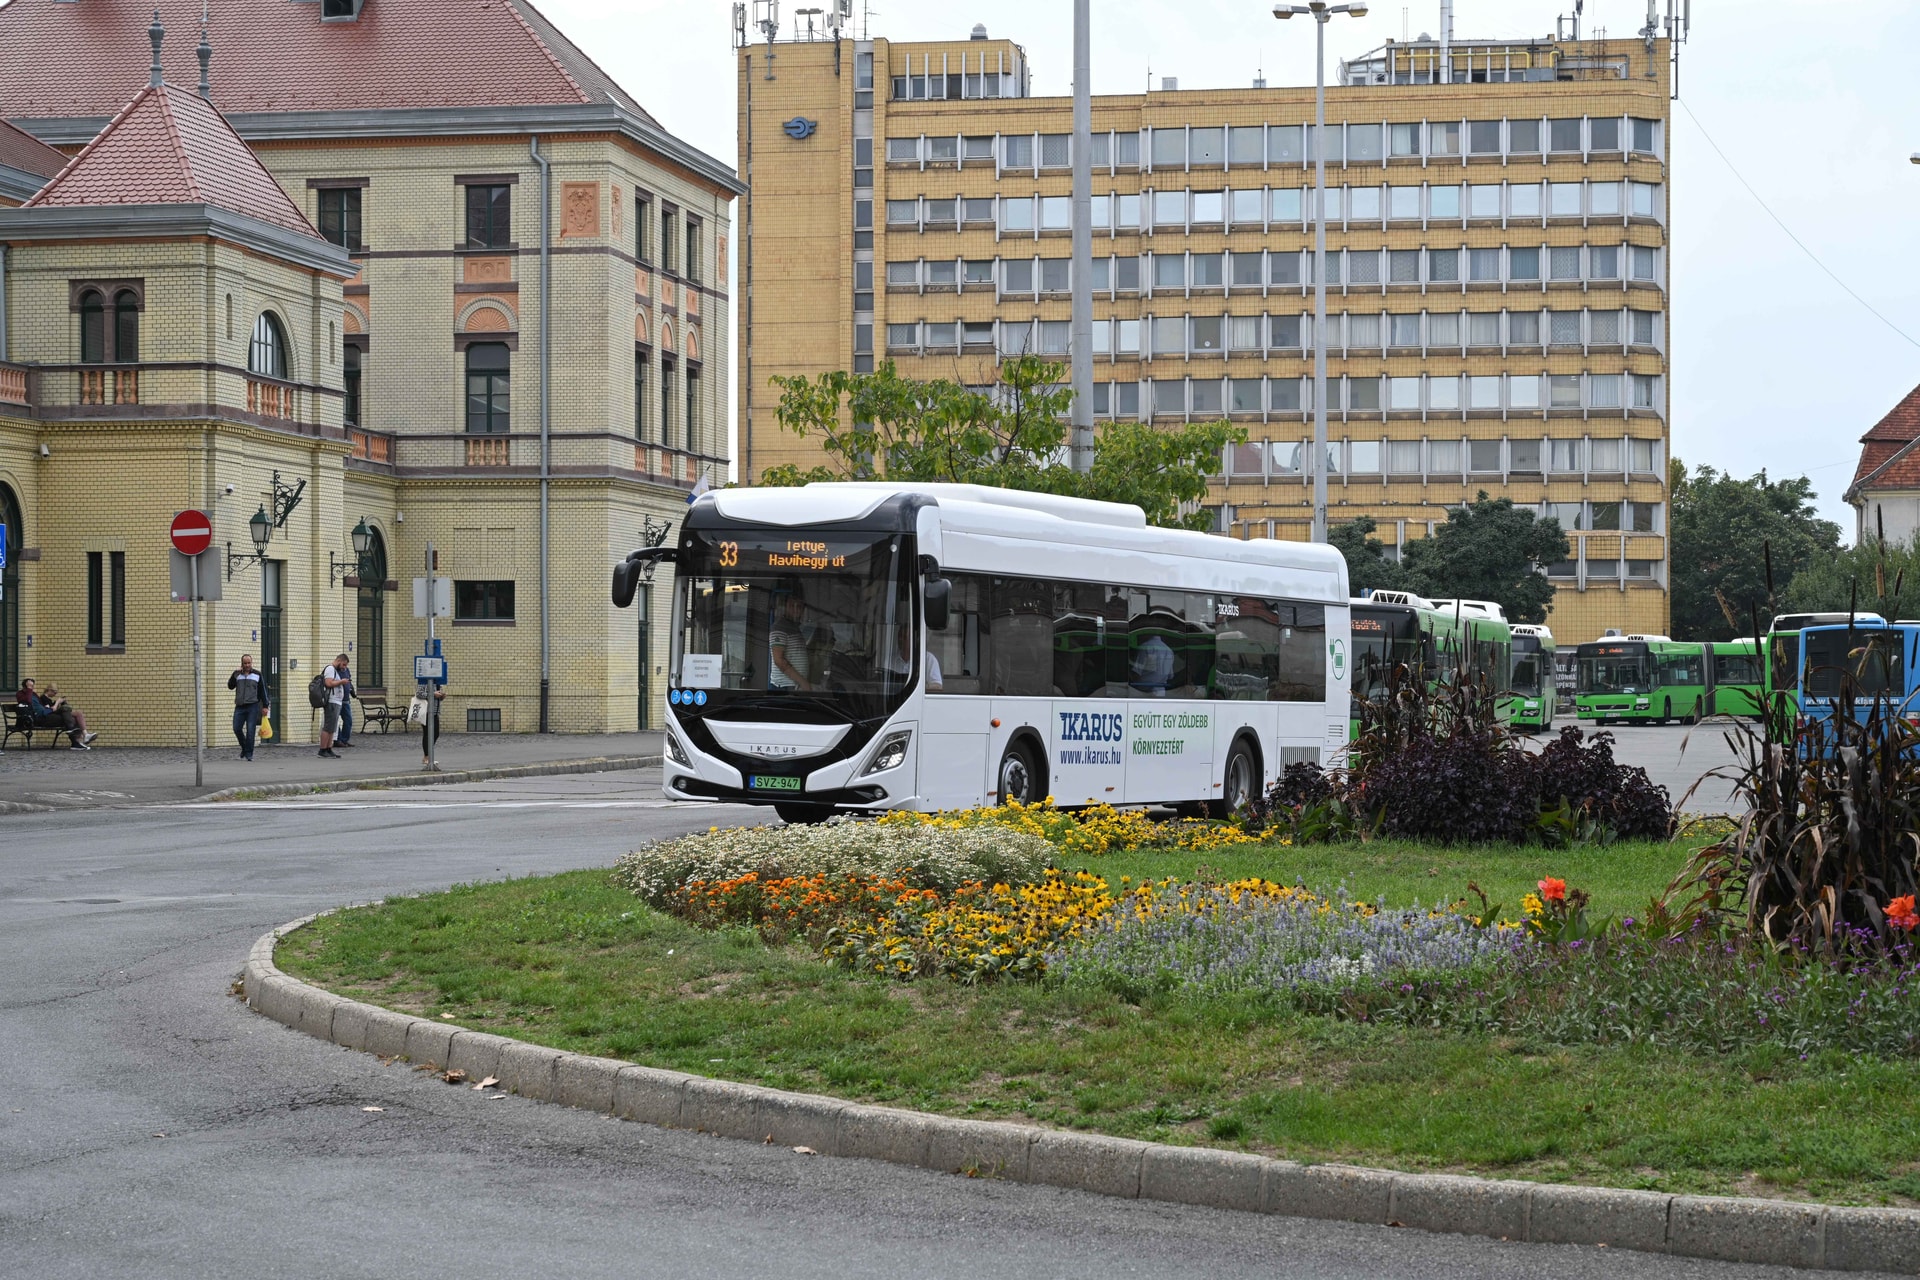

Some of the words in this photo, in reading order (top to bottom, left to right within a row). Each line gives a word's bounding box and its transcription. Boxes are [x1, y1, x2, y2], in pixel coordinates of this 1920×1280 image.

[719, 541, 738, 567] 33
[768, 553, 828, 569] Havihegyi
[1216, 603, 1240, 616] IKARUS
[1059, 712, 1122, 742] IKARUS
[1133, 711, 1162, 729] EGYÜTT
[1163, 714, 1177, 729] EGY
[1178, 711, 1209, 729] ZÖLDEBB
[750, 745, 797, 754] IKARUS
[1132, 737, 1185, 755] KÖRNYEZETÉRT
[1060, 746, 1121, 765] www.ikarus.hu
